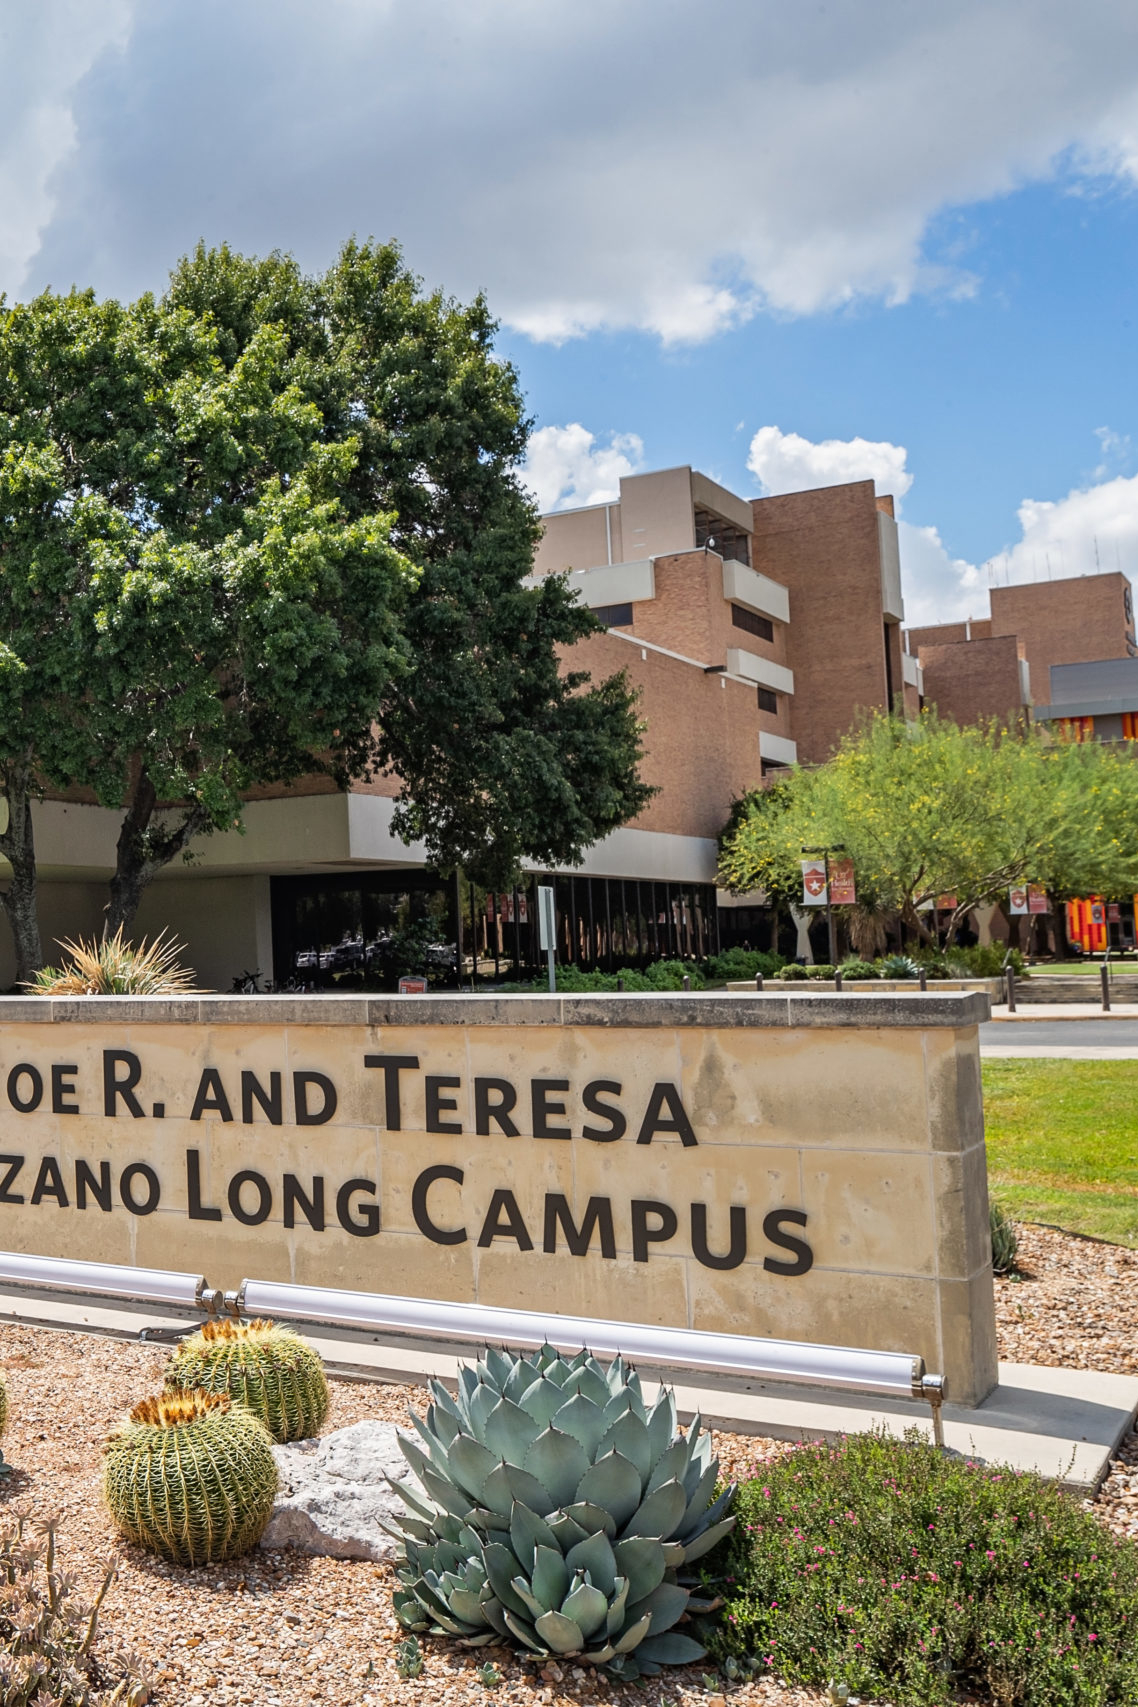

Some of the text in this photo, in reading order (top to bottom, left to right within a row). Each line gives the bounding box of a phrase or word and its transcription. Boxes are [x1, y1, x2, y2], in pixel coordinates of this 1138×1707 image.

[103, 1050, 164, 1120] R.
[190, 1069, 337, 1125] AND
[364, 1055, 698, 1147] TERESA
[187, 1150, 380, 1238] LONG
[412, 1165, 813, 1277] CAMPUS
